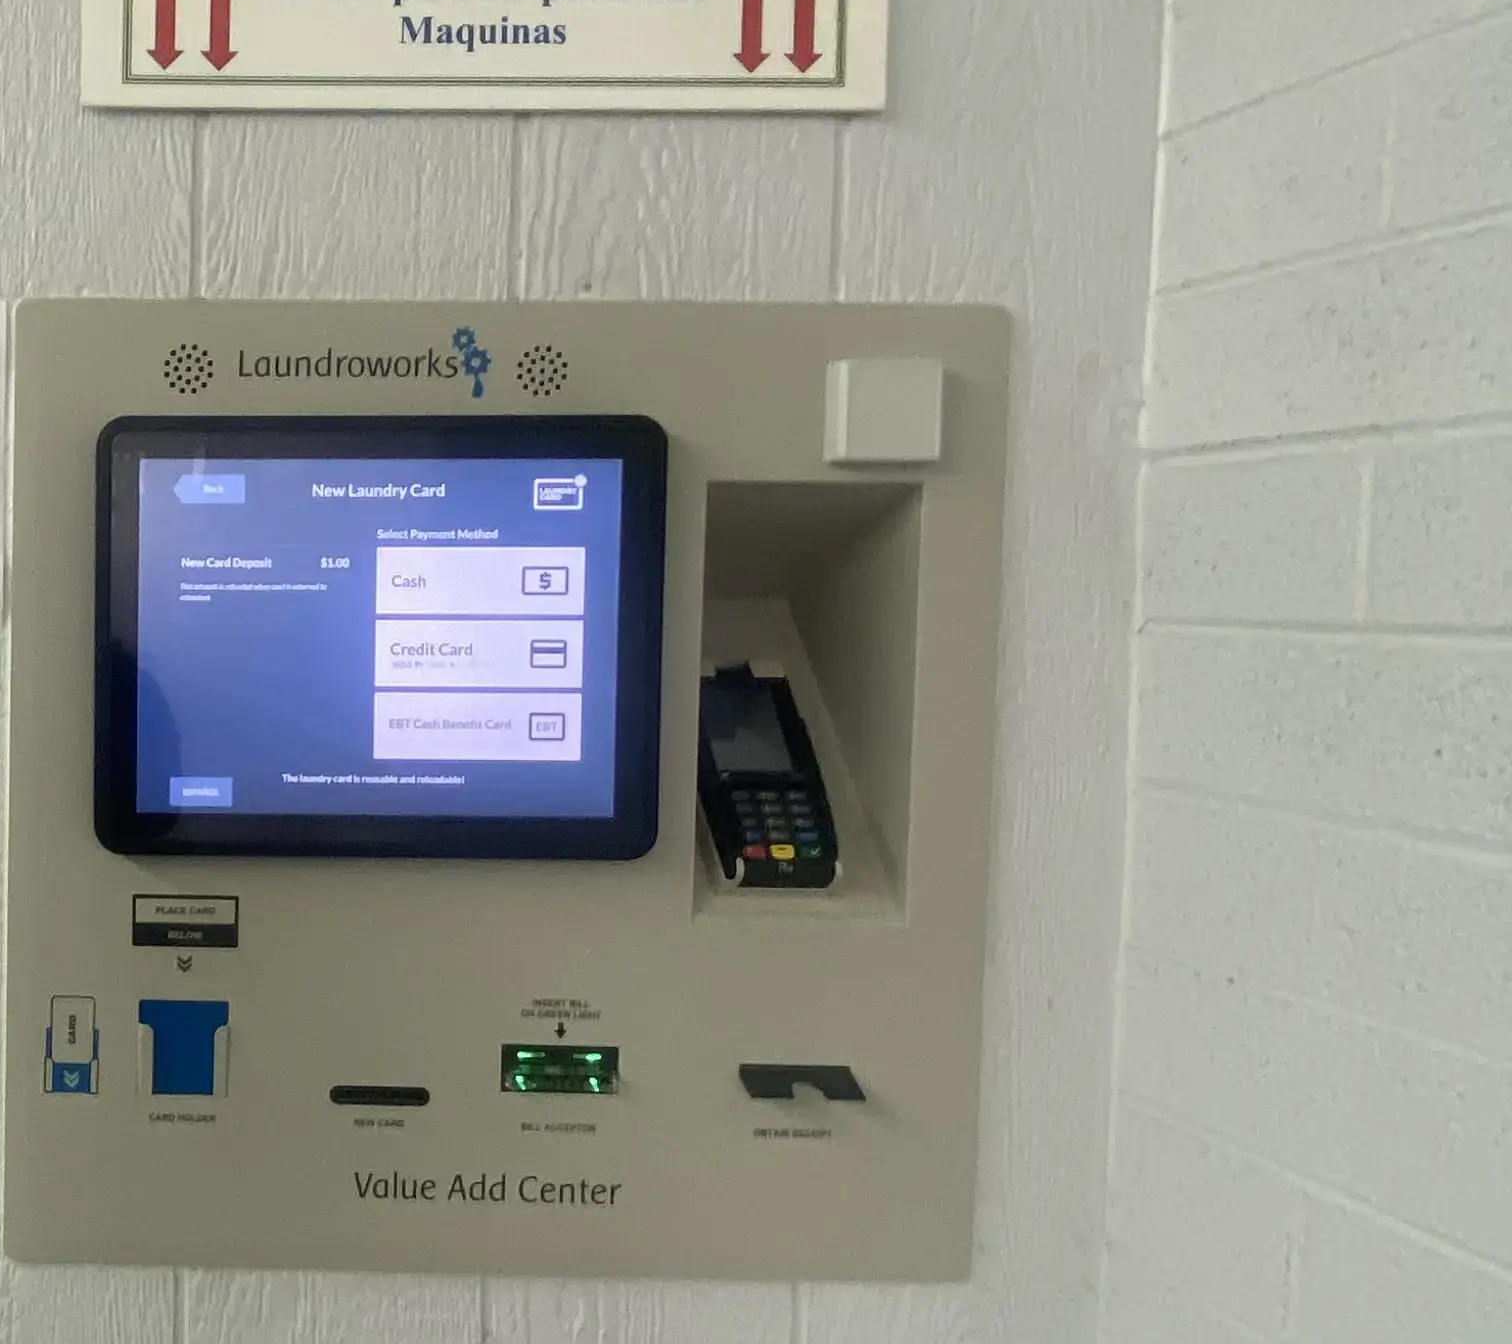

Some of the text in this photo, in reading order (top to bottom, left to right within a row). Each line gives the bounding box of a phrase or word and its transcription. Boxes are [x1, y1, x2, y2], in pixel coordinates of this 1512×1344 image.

[398, 15, 568, 53] Maquinas
[237, 347, 458, 379] Laundroworks
[311, 483, 446, 499] New Laundry Card
[377, 529, 499, 541] Select Payment Method
[181, 557, 272, 570] New Card Deposit
[320, 557, 350, 569] $1.00
[391, 574, 426, 589] Cash
[390, 642, 473, 657] Credit Card
[388, 718, 512, 730] EBT Cash Benefit Card
[354, 1171, 623, 1205] Value Add Center
